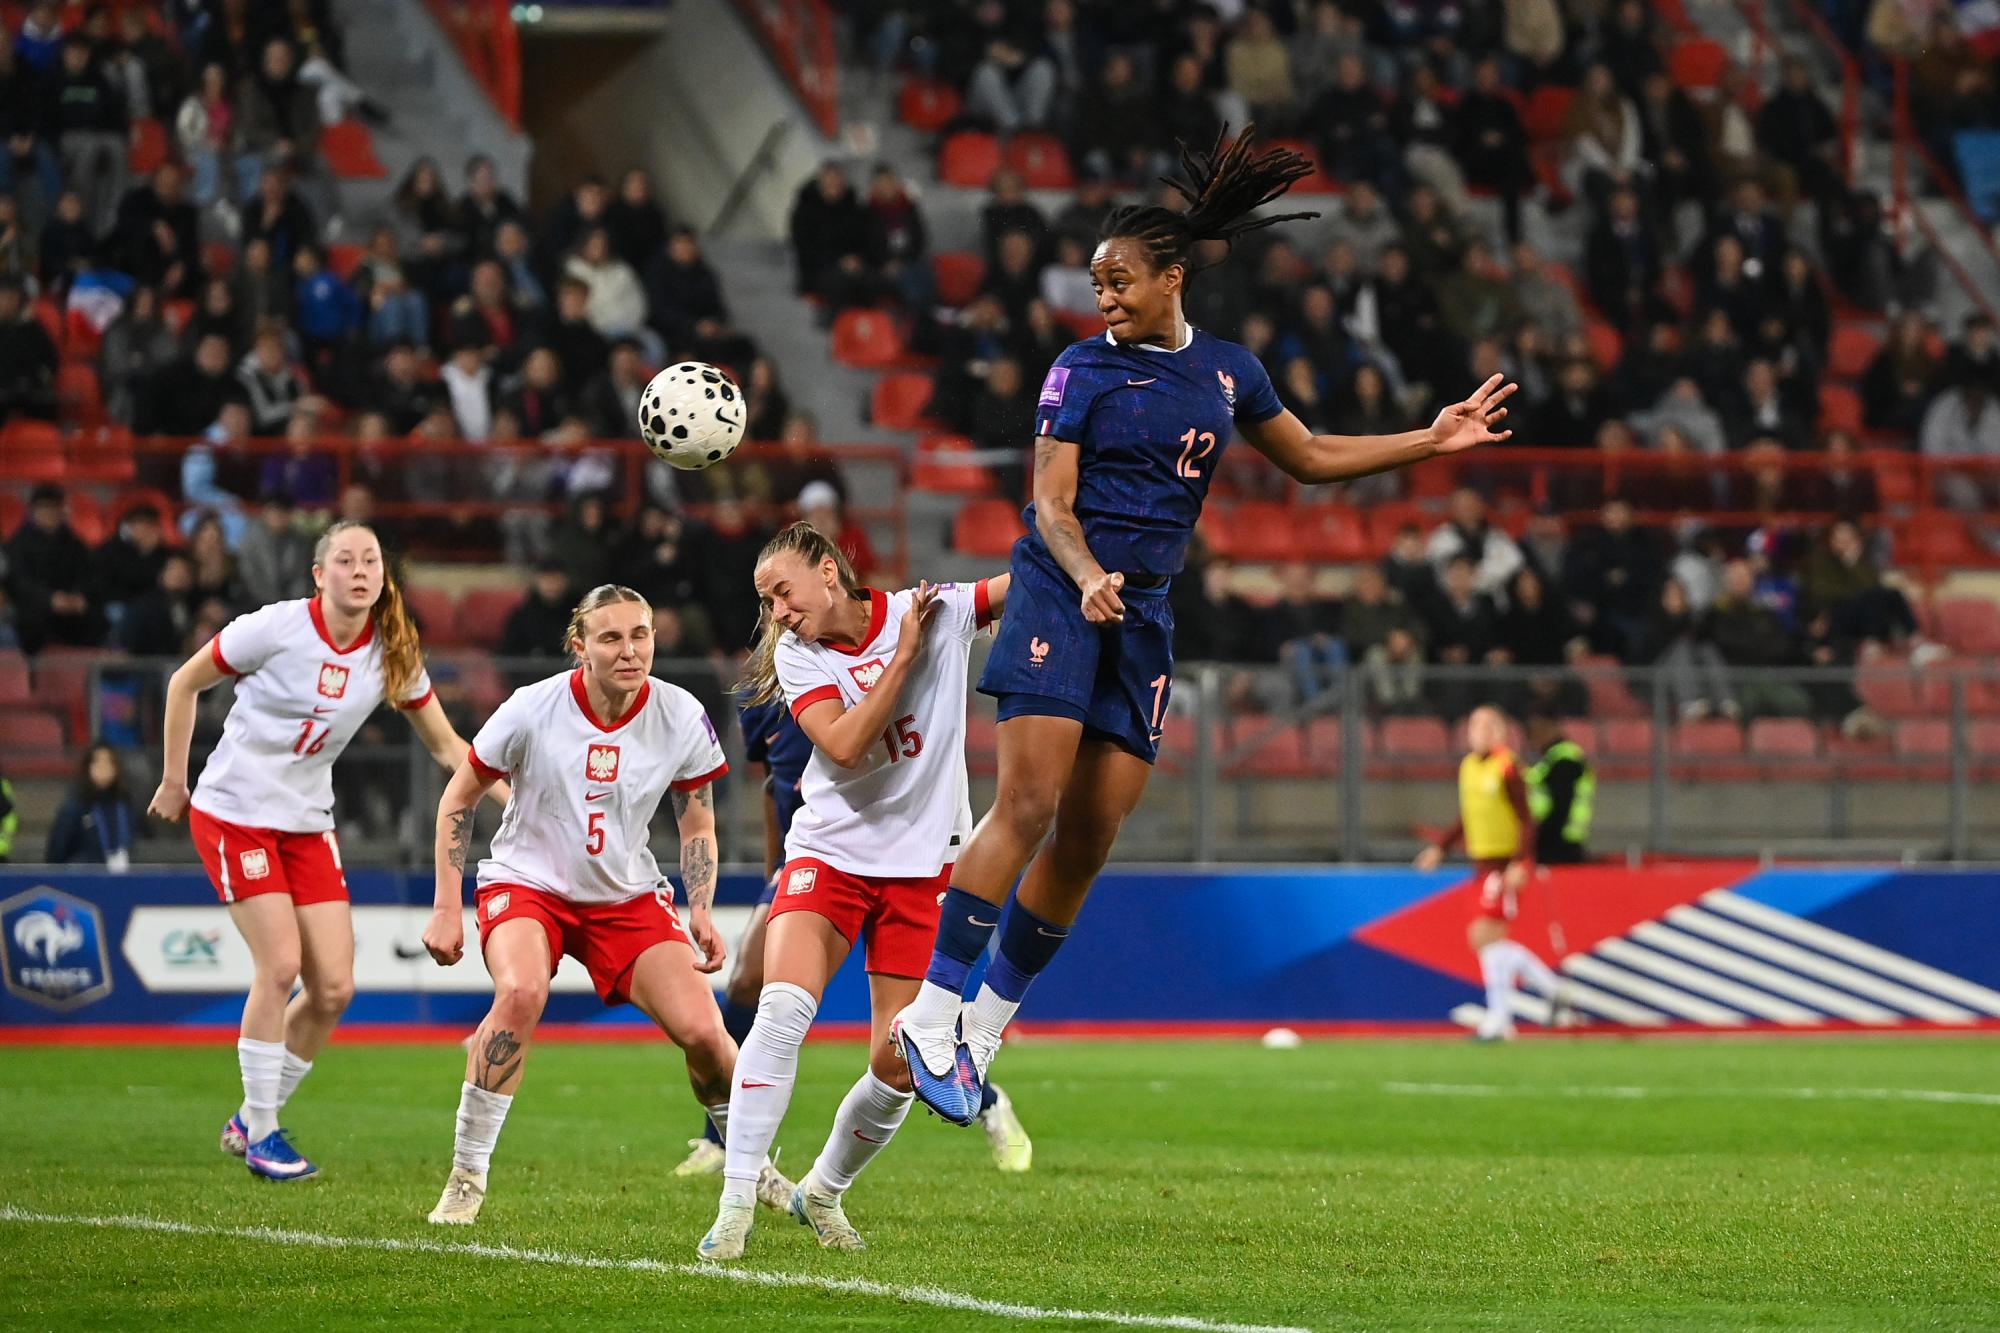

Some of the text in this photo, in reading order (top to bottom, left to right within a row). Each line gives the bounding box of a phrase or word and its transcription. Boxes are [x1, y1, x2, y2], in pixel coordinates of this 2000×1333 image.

[1177, 428, 1216, 478] 12
[1150, 674, 1173, 730] 1
[293, 719, 331, 755] 16
[879, 713, 924, 764] 15
[585, 811, 605, 856] 5
